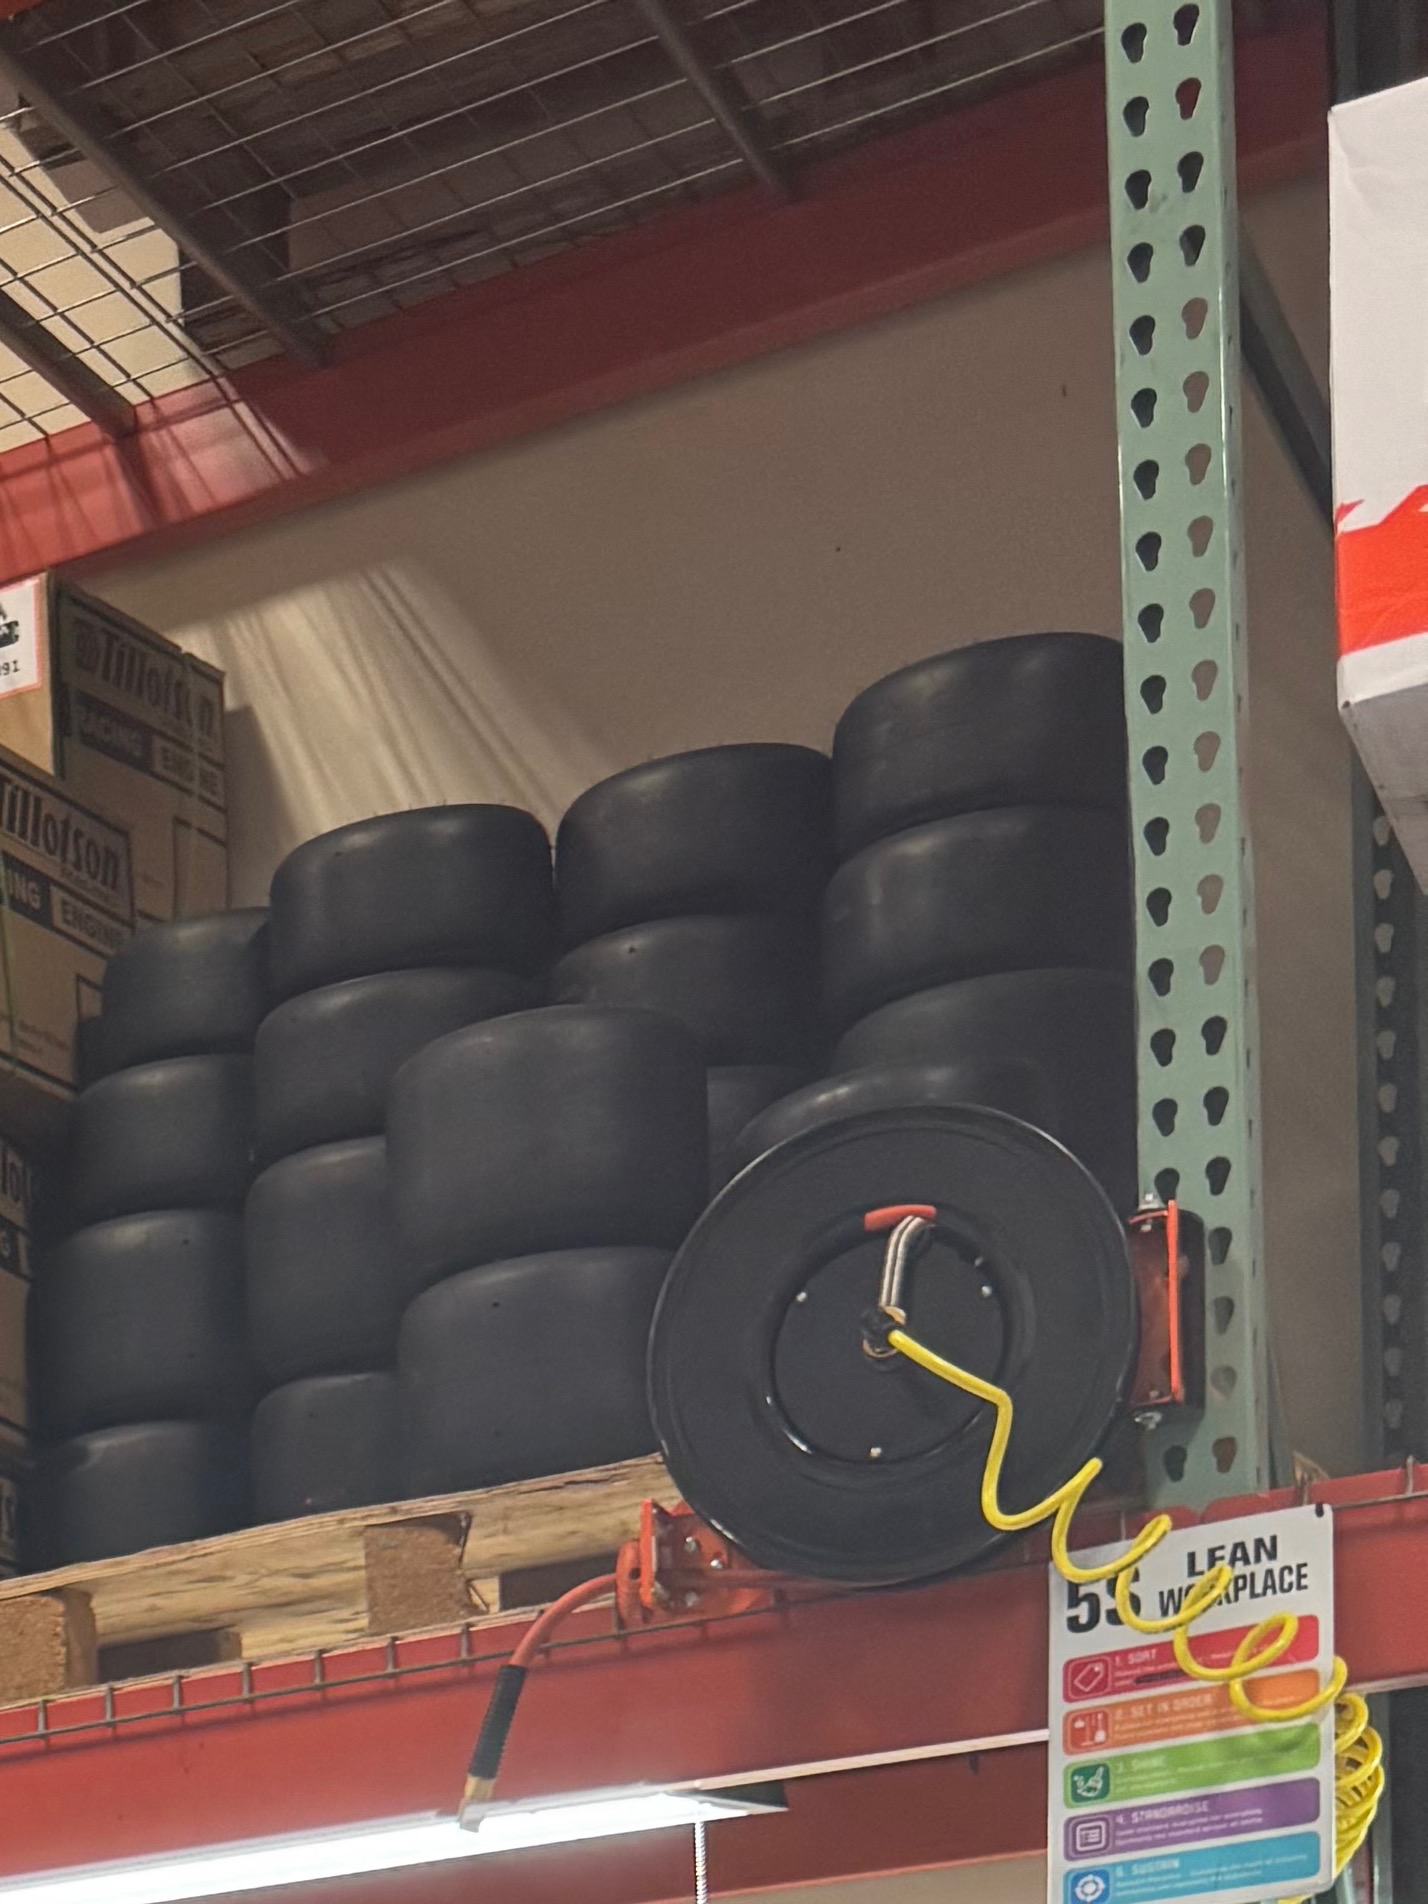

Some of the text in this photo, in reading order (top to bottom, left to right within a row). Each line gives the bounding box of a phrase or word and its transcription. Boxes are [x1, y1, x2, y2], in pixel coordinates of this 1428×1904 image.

[1065, 1534, 1279, 1634] 5S LEAN
[1128, 1649, 1158, 1663] SORT
[1130, 1702, 1152, 1717] SET
